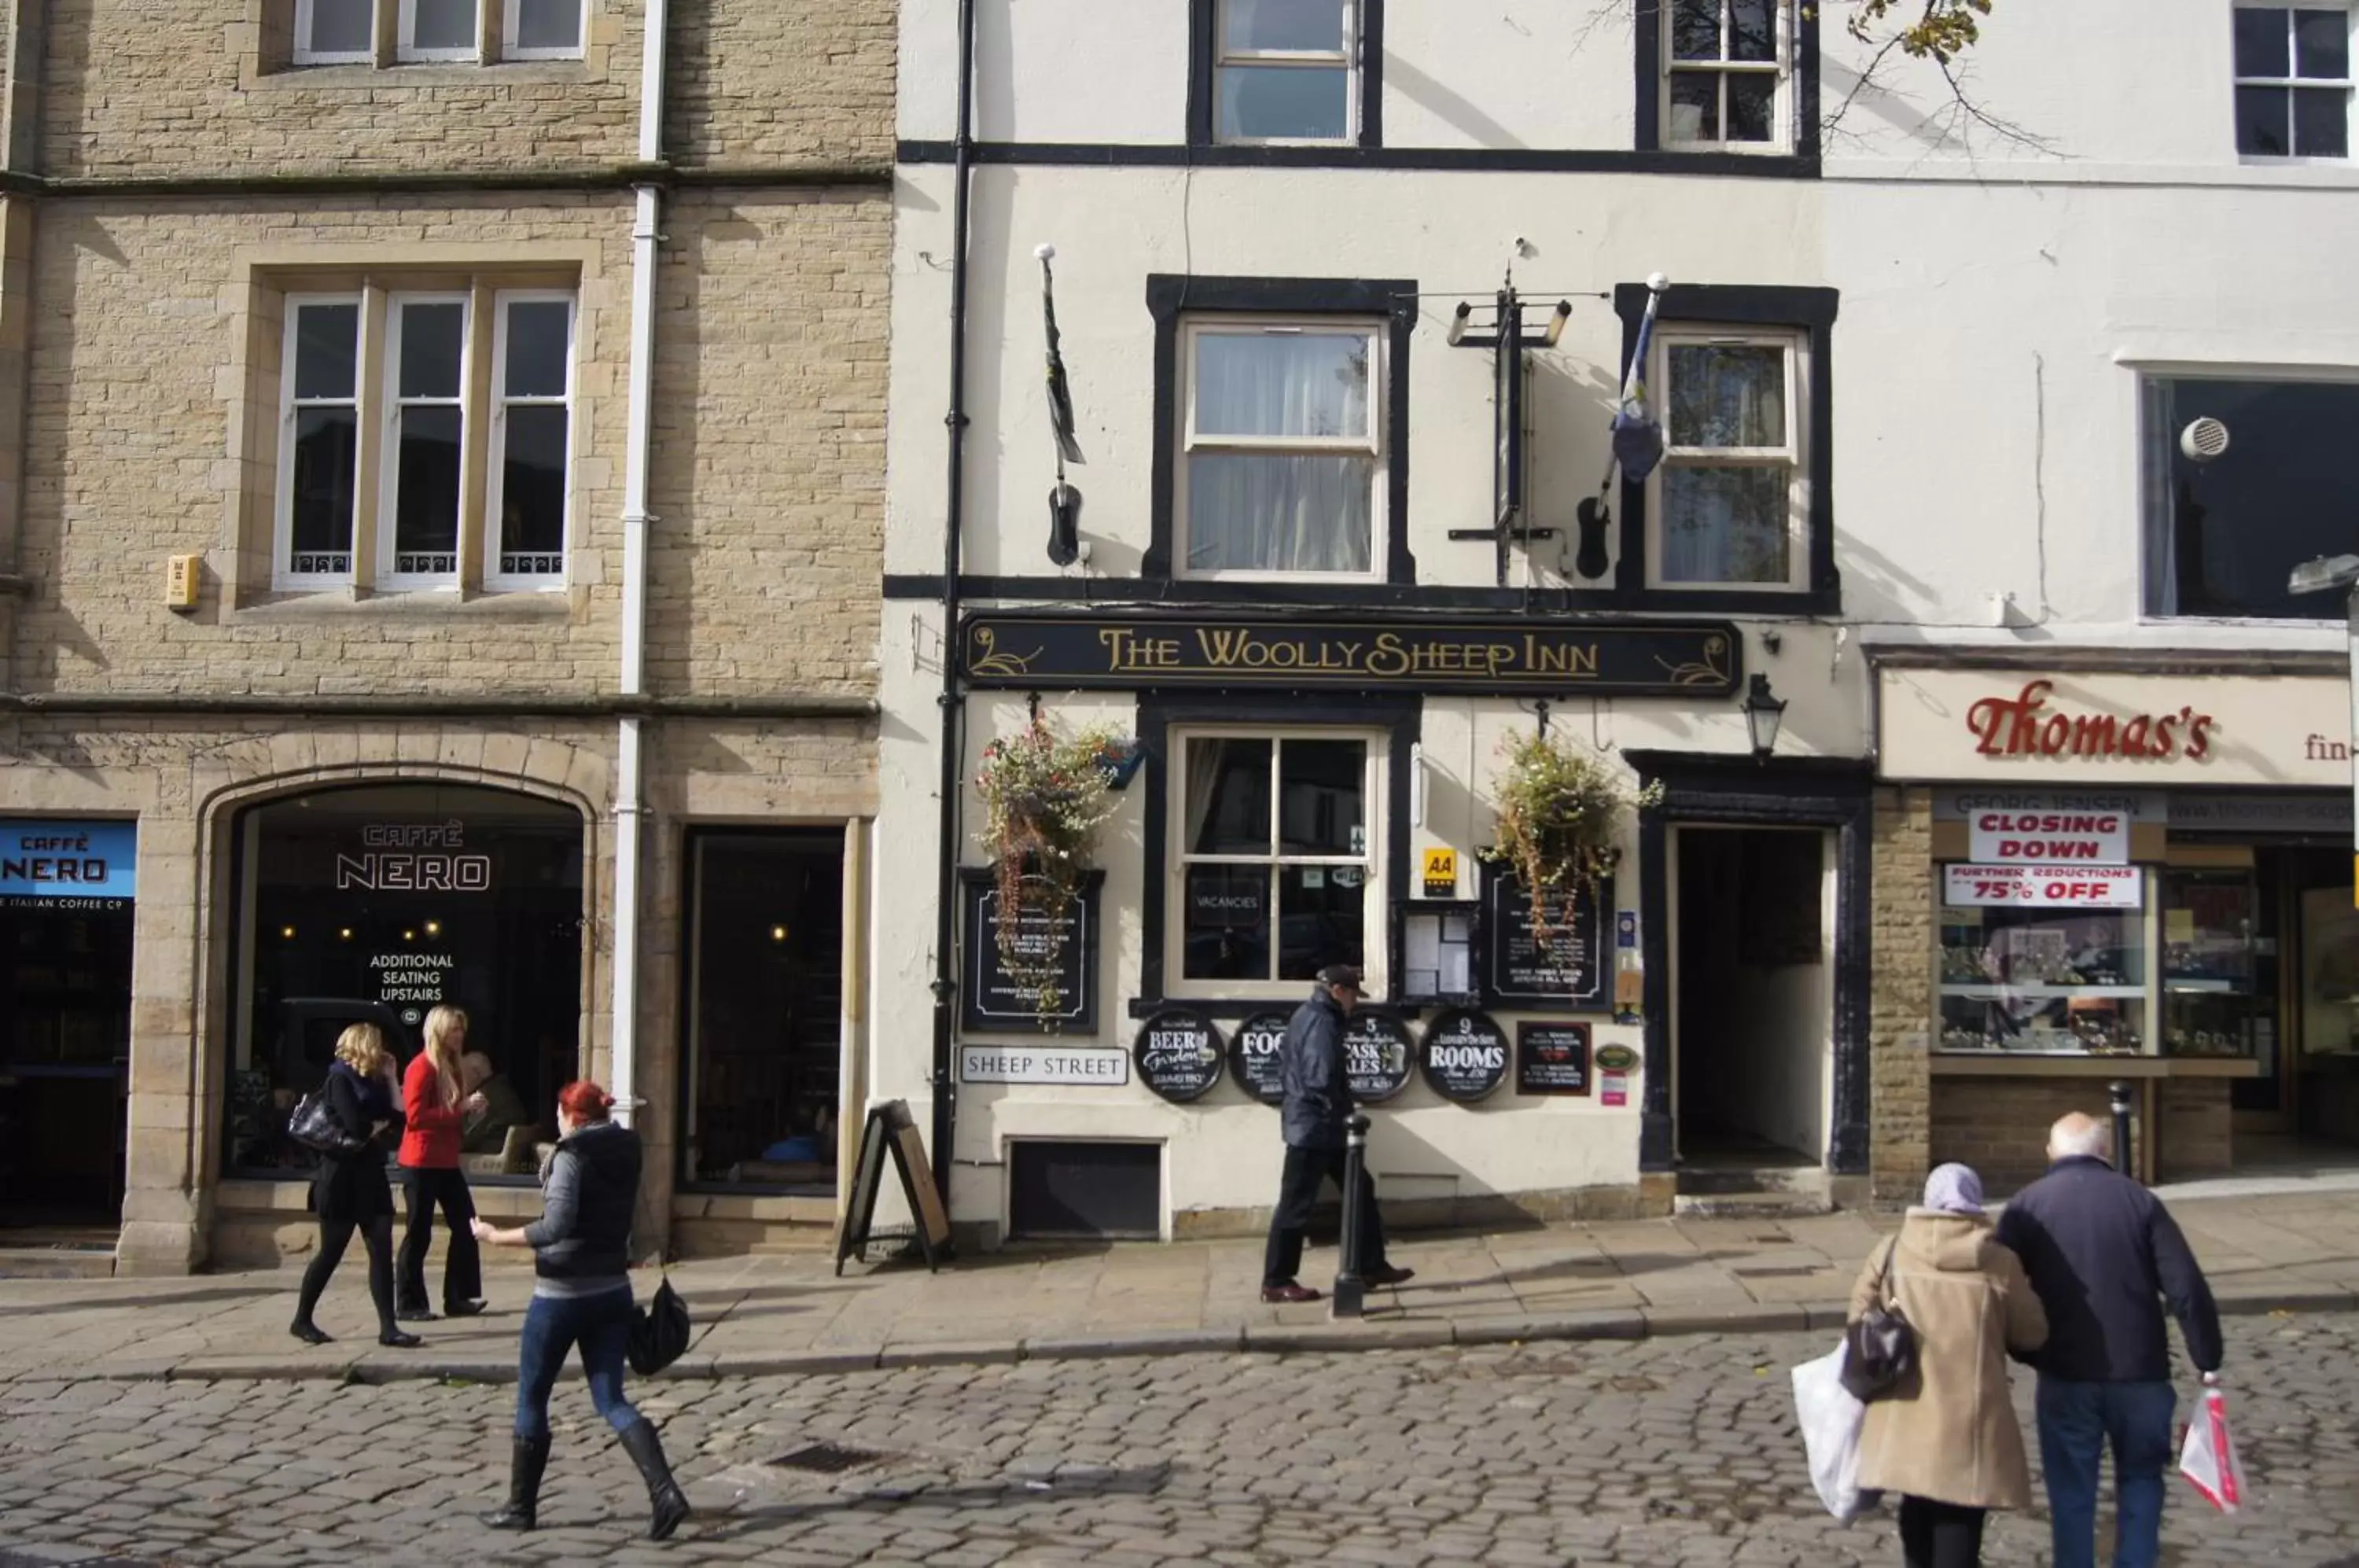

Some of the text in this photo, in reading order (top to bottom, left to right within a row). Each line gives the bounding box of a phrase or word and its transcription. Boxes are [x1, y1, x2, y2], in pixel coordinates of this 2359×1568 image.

[1099, 628, 1599, 677] THE WOOLLY SHEEP INN
[1966, 679, 2214, 758] Thomas's
[1978, 814, 2118, 834] CLOSING
[1998, 840, 2100, 859] DOWN
[2, 857, 108, 883] NERO
[337, 852, 491, 890] NERO
[1428, 856, 1452, 874] AA
[1952, 867, 2133, 879] FURTHER REDUCTIONS
[1973, 880, 2110, 900] 75% OFF
[9, 898, 54, 907] ITALIAN
[59, 899, 101, 909] COFFEE
[1195, 895, 1258, 909] VACANCIES
[370, 954, 454, 968] ADDITIONAL
[382, 970, 441, 985] SEATING
[381, 988, 442, 1002] UPSTAIRS
[1366, 1018, 1377, 1032] 5
[1459, 1018, 1472, 1035] 9
[1149, 1031, 1197, 1050] BEER
[968, 1056, 1121, 1075] SHEEP STREET
[1429, 1045, 1505, 1069] ROOMS
